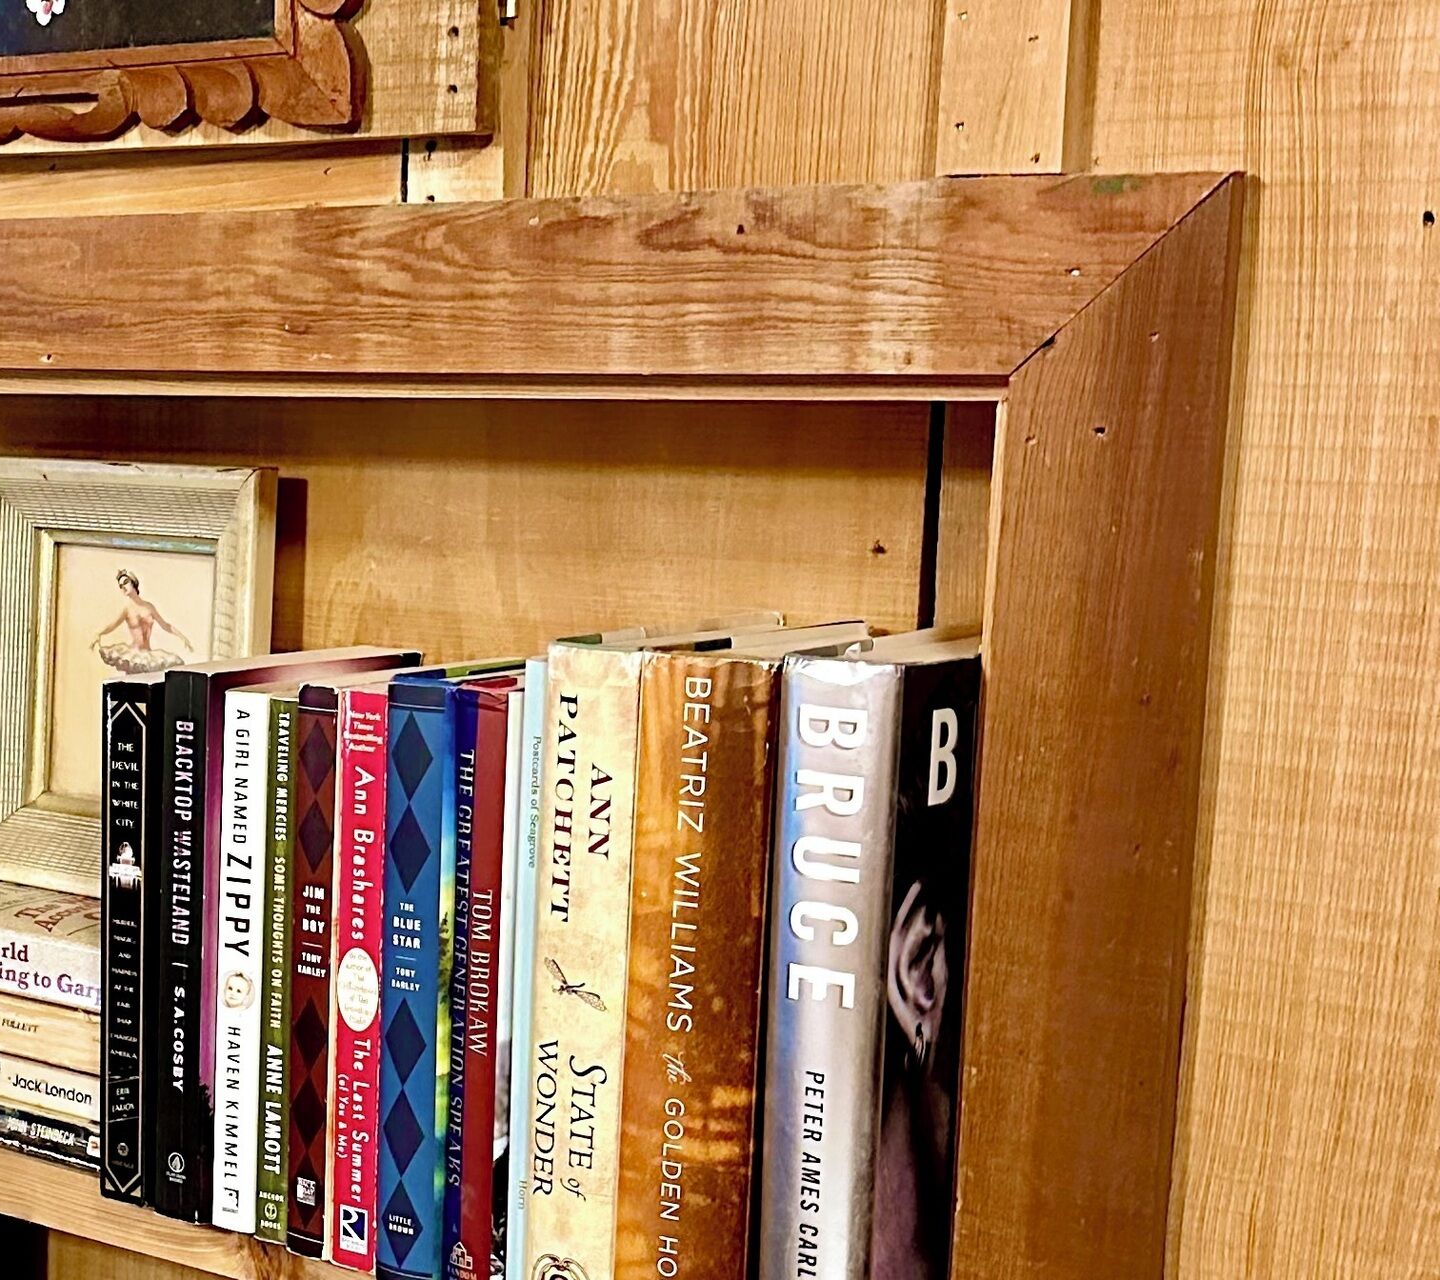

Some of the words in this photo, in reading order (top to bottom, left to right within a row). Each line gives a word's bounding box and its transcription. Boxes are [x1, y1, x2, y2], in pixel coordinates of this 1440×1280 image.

[236, 708, 251, 720] A
[111, 760, 140, 772] DEVIL
[117, 741, 135, 752] THE
[174, 719, 195, 822] BLACKTOP
[234, 728, 251, 770] GIRL
[275, 712, 291, 782] TRAVELING
[459, 748, 476, 798] THE
[676, 676, 713, 834] BEATRIZ
[111, 798, 140, 810] WHITE
[231, 777, 250, 846] NAMED
[274, 787, 289, 842] MERCIES
[352, 765, 377, 817] Ann
[550, 693, 579, 924] PATCHETT
[587, 762, 614, 861] ANN
[115, 818, 136, 830] CITY
[273, 856, 286, 893] SOME
[454, 805, 474, 927] GREATEST
[787, 702, 869, 1010] BRUCE
[170, 829, 193, 947] WASTELAND
[224, 852, 253, 958] ZIPPY
[301, 884, 326, 901] JIM
[350, 829, 376, 942] Brashares
[271, 896, 286, 964] THOUGHTS
[301, 917, 326, 935] BOY
[392, 915, 422, 932] BLUE
[471, 888, 494, 942] TOM
[301, 951, 323, 964] TONY
[392, 934, 422, 951] STAR
[665, 852, 703, 1033] WILLIAMS
[270, 969, 284, 988] ON
[297, 964, 327, 979] EARLEY
[391, 978, 421, 992] EARLEY
[395, 966, 417, 979] TONY
[270, 990, 285, 1030] FAITH
[451, 936, 467, 1087] GENERATION
[467, 949, 493, 1057] BROKAW
[225, 1025, 241, 1091] HAVEN
[264, 1043, 284, 1096] ANNE
[352, 1038, 372, 1073] The
[662, 1052, 692, 1086] The
[11, 1072, 42, 1094] Jack
[44, 1078, 93, 1106] London
[352, 1080, 371, 1121] Last
[802, 1069, 826, 1143] PETER
[223, 1099, 240, 1187] KIMMEL
[262, 1100, 282, 1176] LAMOTT
[447, 1095, 464, 1187] SPEAKS
[532, 1039, 559, 1197] WONDER
[350, 1130, 370, 1203] Summer
[659, 1097, 685, 1221] GOLDEN
[799, 1151, 822, 1214] AMES
